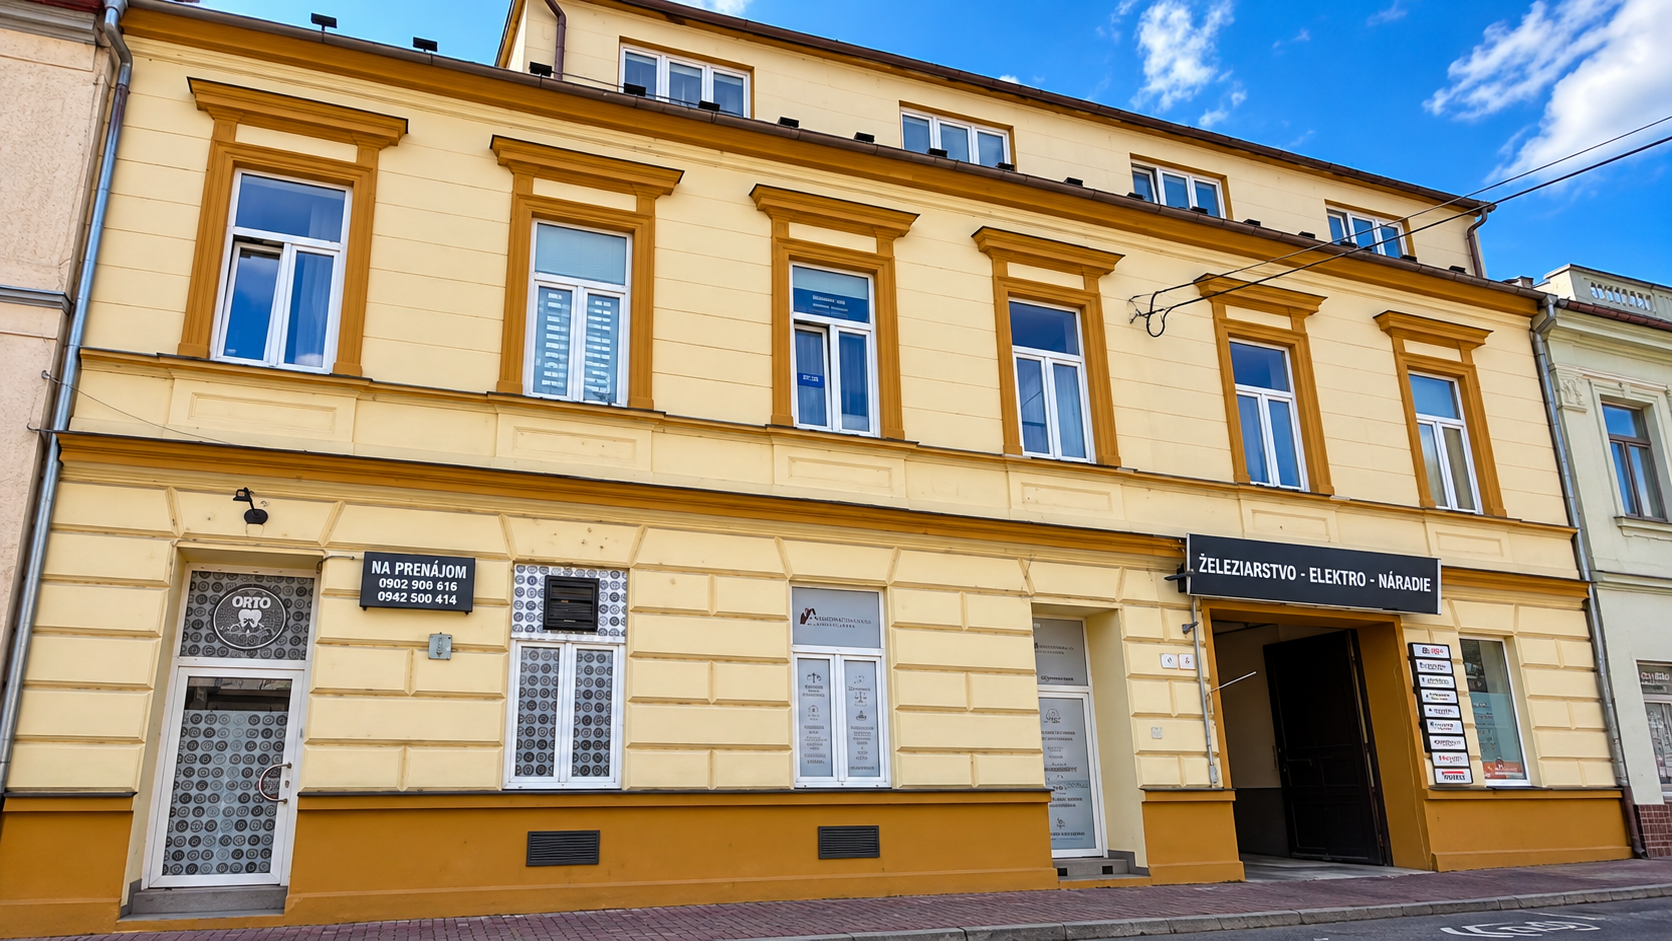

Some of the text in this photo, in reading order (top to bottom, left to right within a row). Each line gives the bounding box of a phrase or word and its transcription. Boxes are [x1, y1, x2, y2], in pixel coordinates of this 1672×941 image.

[371, 560, 467, 579] NA PRENÁJOM
[1199, 553, 1297, 581] ŽELEZIARSTVO
[1309, 567, 1366, 587] ELEKTRO
[1378, 570, 1431, 592] NÁRADIE
[379, 578, 408, 589] 0902
[436, 581, 458, 592] 616
[231, 595, 271, 609] ORTO
[377, 591, 457, 605] 0942 500 414
